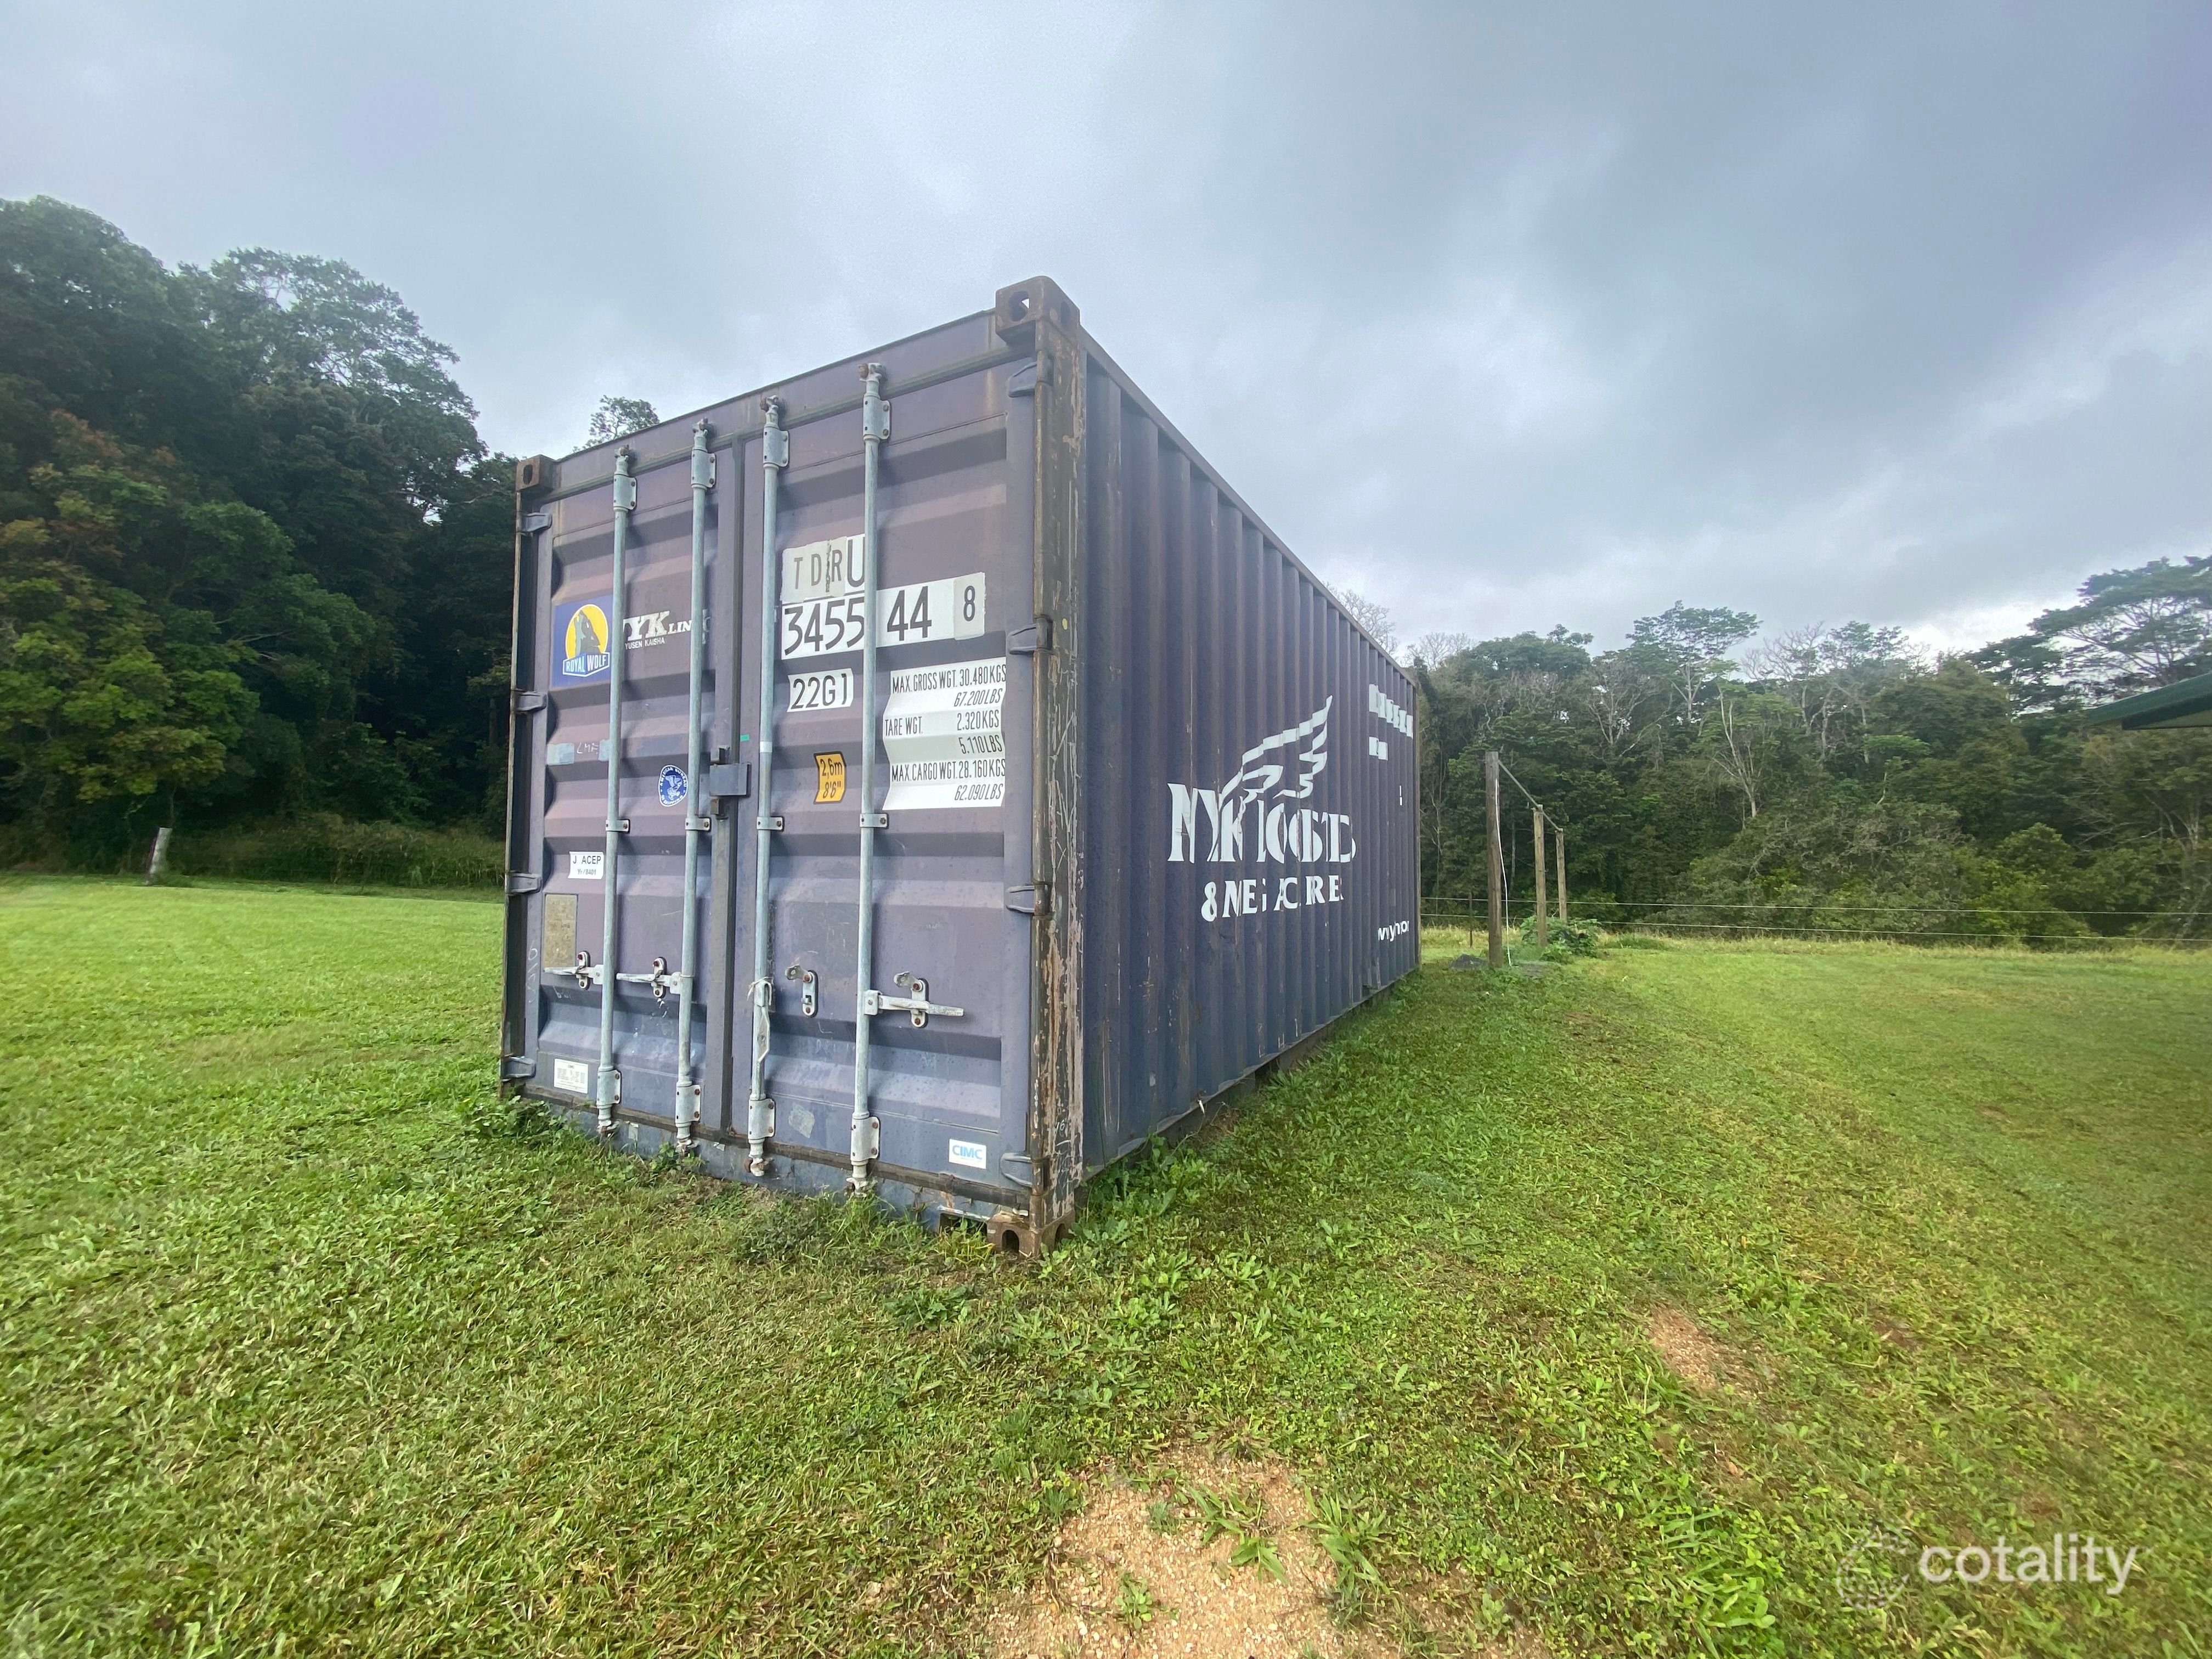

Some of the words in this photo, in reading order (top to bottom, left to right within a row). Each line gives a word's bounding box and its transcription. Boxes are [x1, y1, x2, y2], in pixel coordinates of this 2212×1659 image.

[963, 585, 975, 622] 8
[623, 610, 670, 641] YK
[625, 640, 642, 650] YUSEN
[645, 636, 665, 647] KAISHA
[566, 657, 585, 672] ROYAL
[587, 654, 606, 671] WOLF
[791, 673, 848, 709] 22G1
[885, 718, 902, 736] TARE
[820, 758, 843, 780] 2,6m
[573, 855, 577, 864] J
[582, 855, 601, 864] ACEP
[952, 1145, 983, 1159] CIMC
